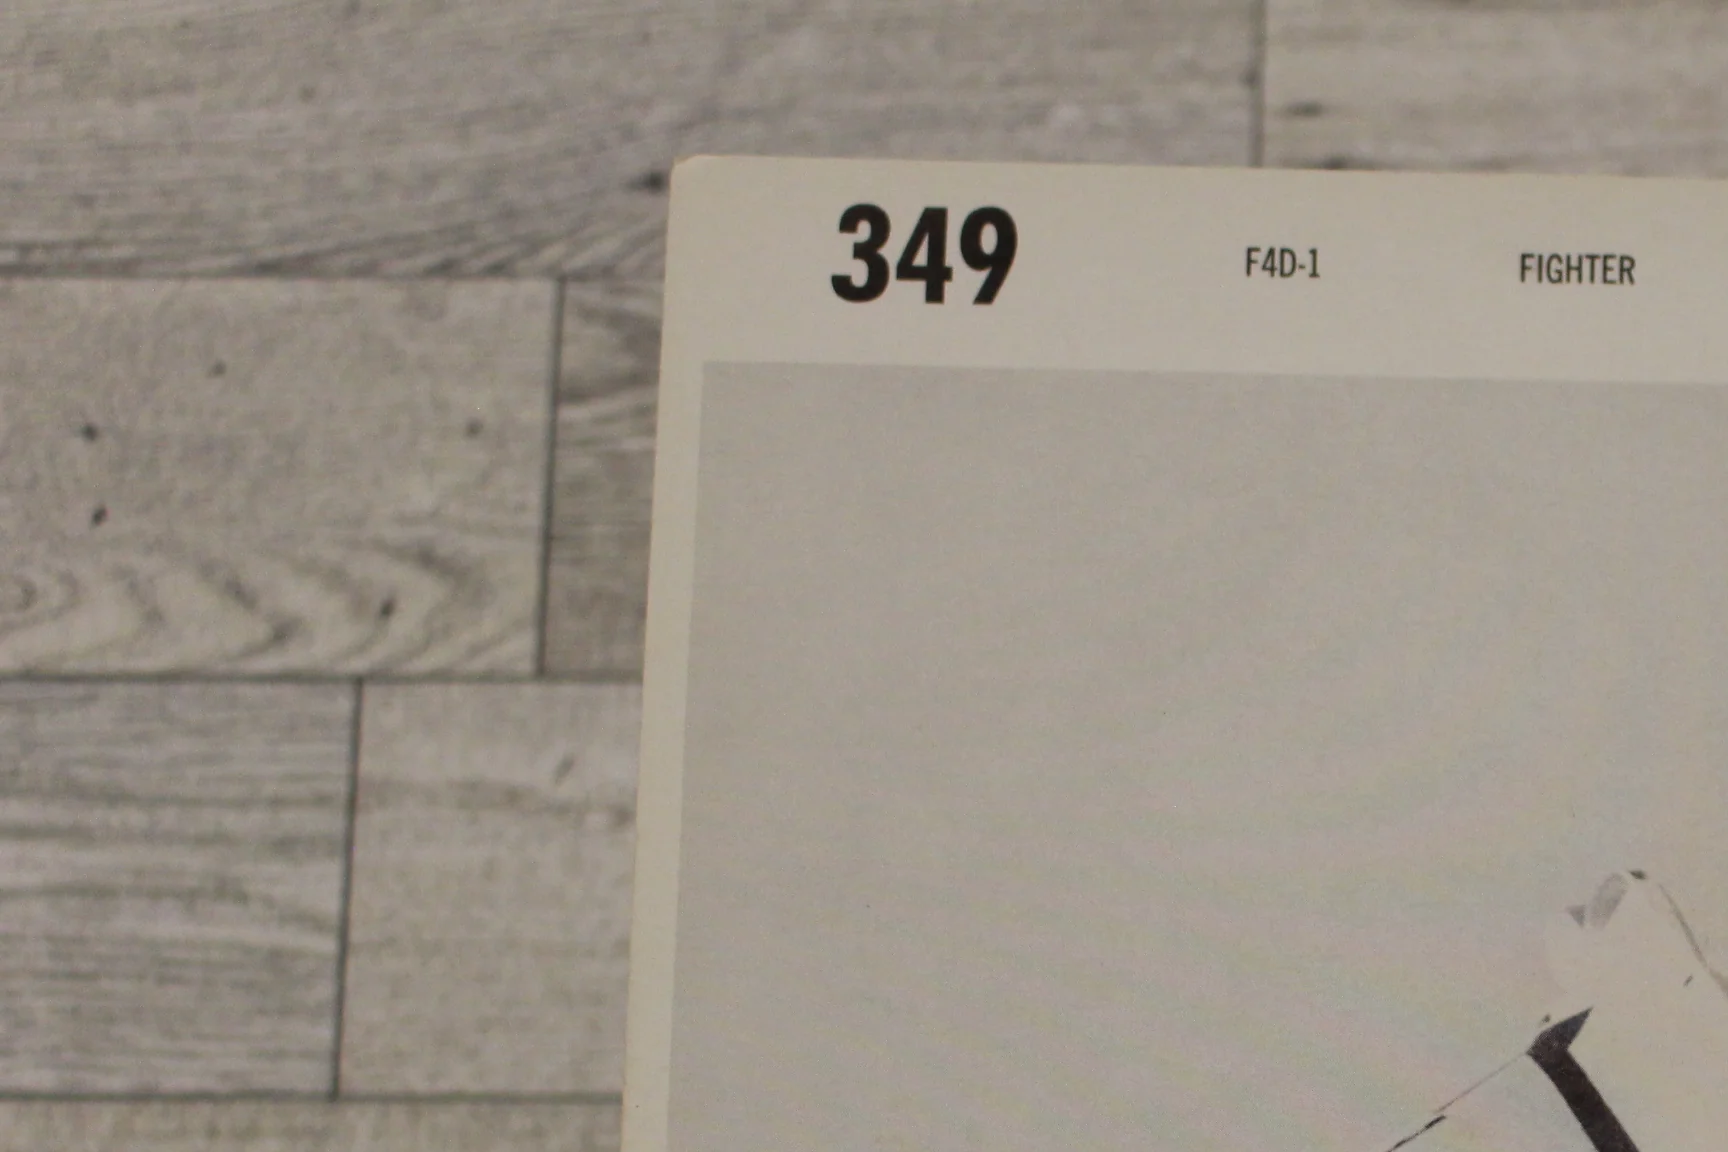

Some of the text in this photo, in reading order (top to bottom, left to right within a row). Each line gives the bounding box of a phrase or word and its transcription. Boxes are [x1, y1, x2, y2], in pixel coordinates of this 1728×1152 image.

[830, 202, 1019, 306] 349
[1244, 246, 1321, 279] F4D-1
[1519, 252, 1637, 286] FIGHTER
